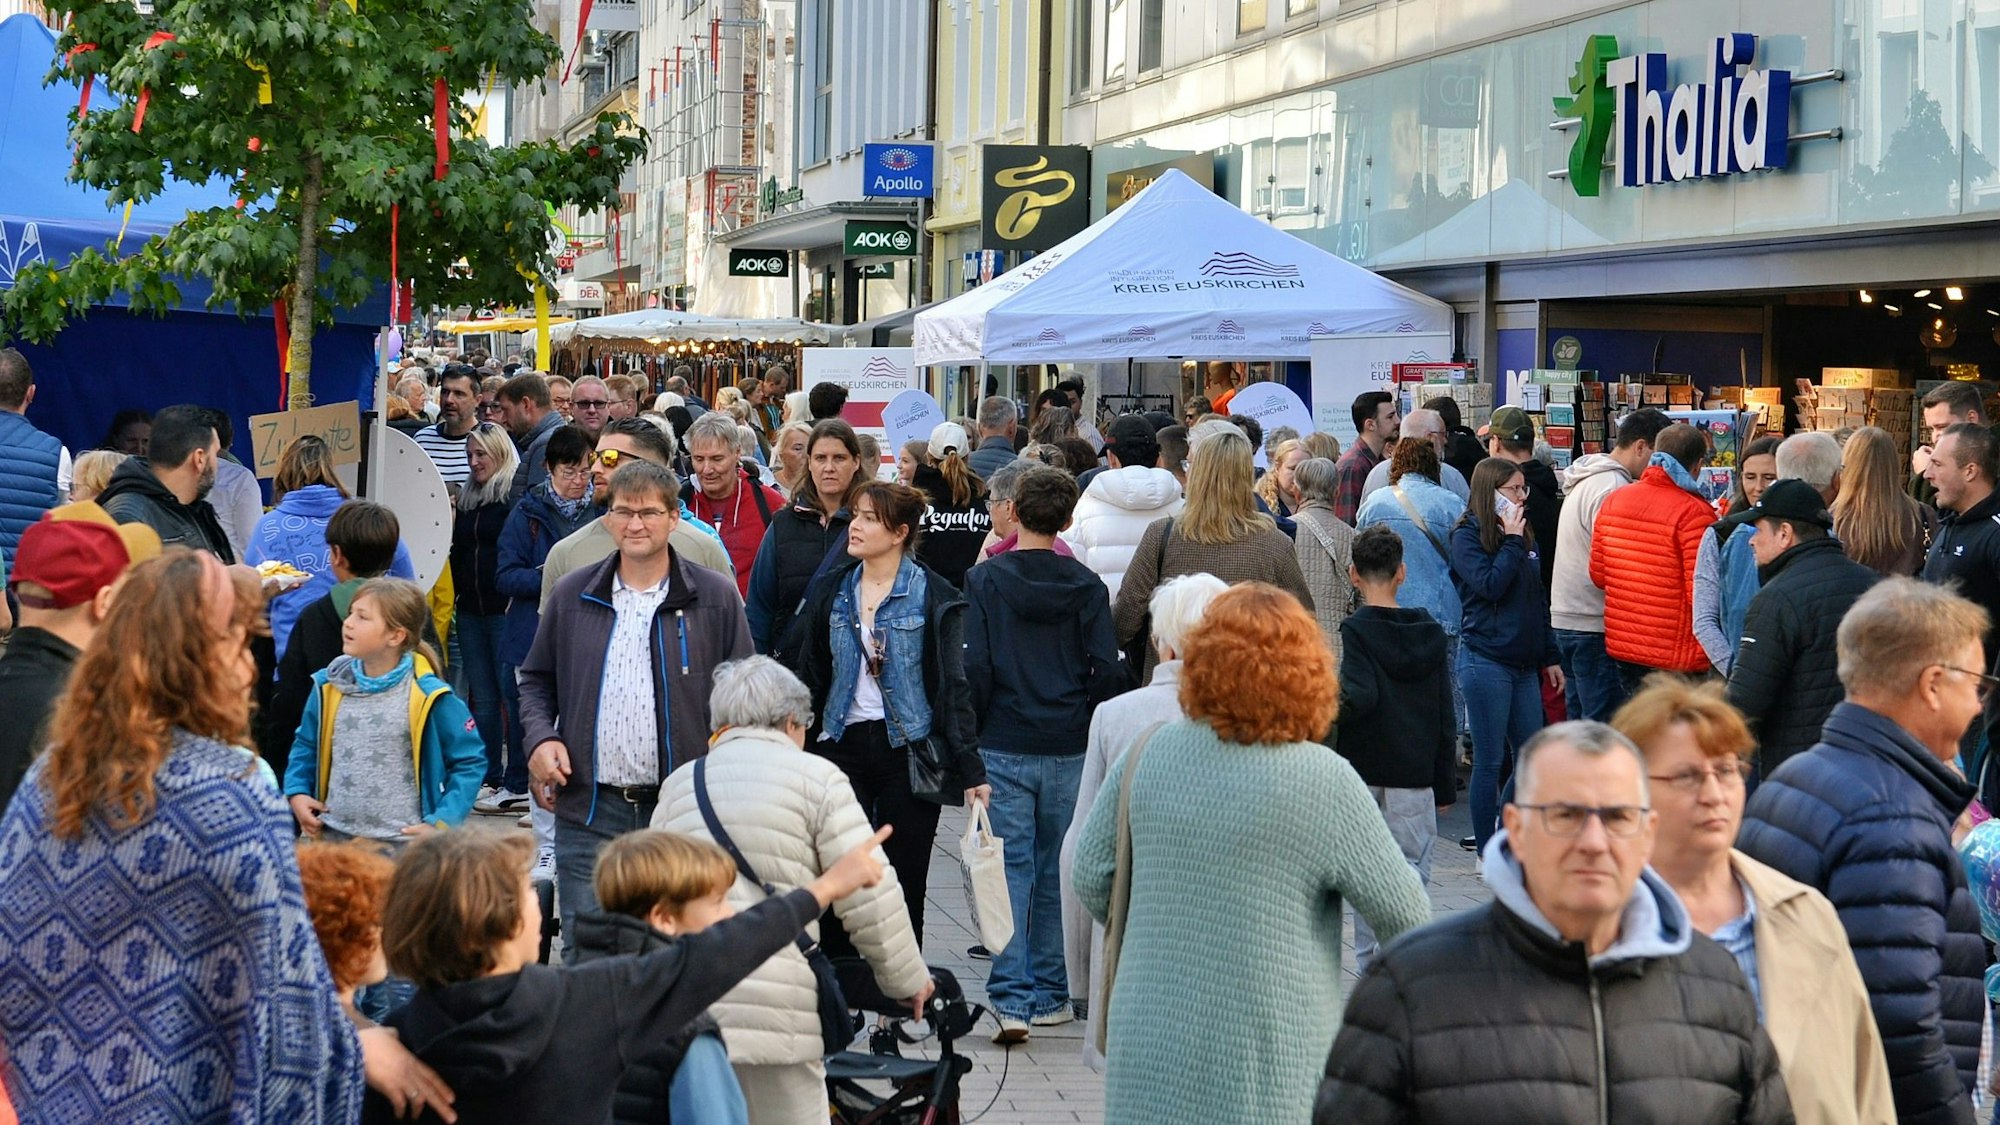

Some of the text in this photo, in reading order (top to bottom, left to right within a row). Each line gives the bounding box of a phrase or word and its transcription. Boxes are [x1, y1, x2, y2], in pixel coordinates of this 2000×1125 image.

[1606, 33, 1780, 187] Thalia
[874, 176, 923, 192] Apollo
[853, 231, 892, 247] AOK
[736, 258, 767, 271] AOK
[580, 289, 599, 298] DER
[1113, 279, 1305, 293] KREIS EUSKIRCHEN
[1545, 370, 1572, 380] happy city
[848, 380, 907, 389] EUSKIRCHEN
[896, 410, 930, 429] EUSKIRCHEN
[919, 505, 990, 532] Pegador
